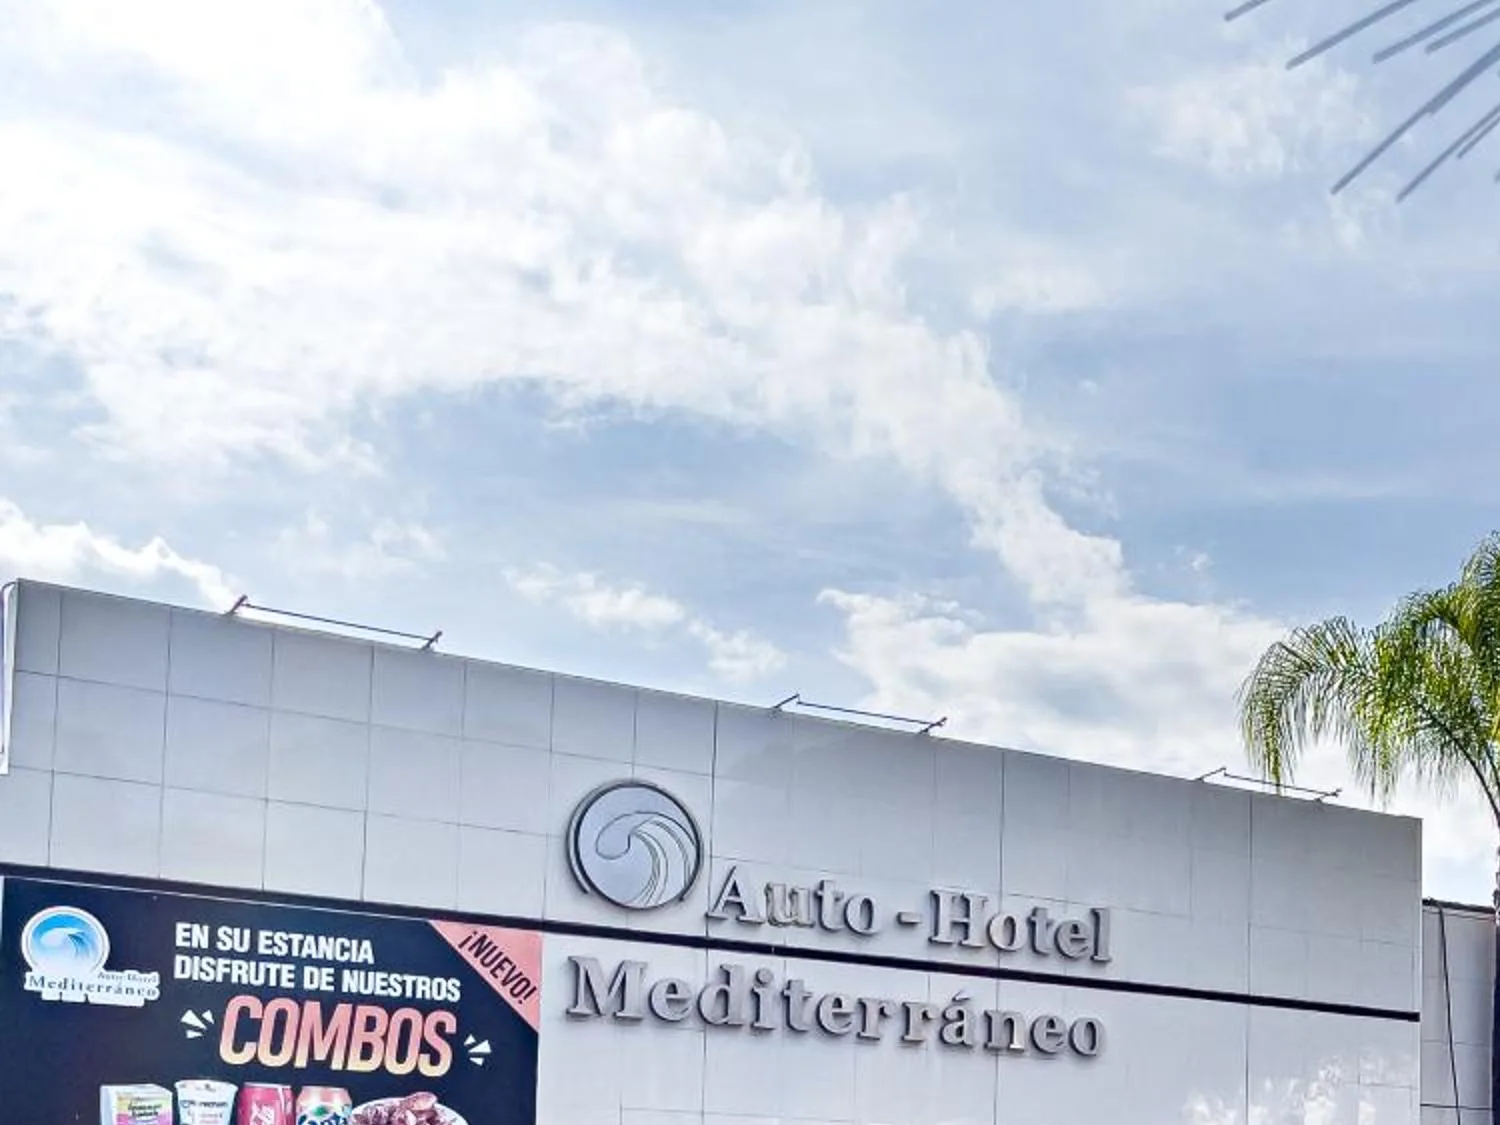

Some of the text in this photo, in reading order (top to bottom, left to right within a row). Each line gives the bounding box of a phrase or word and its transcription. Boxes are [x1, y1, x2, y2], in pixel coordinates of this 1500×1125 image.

[175, 923, 374, 964] EN SU ESTANCIA
[174, 955, 461, 1003] DISFRUTE DE NUESTROS
[566, 953, 1106, 1057] Mediterráneo
[219, 995, 457, 1077] COMBOS
